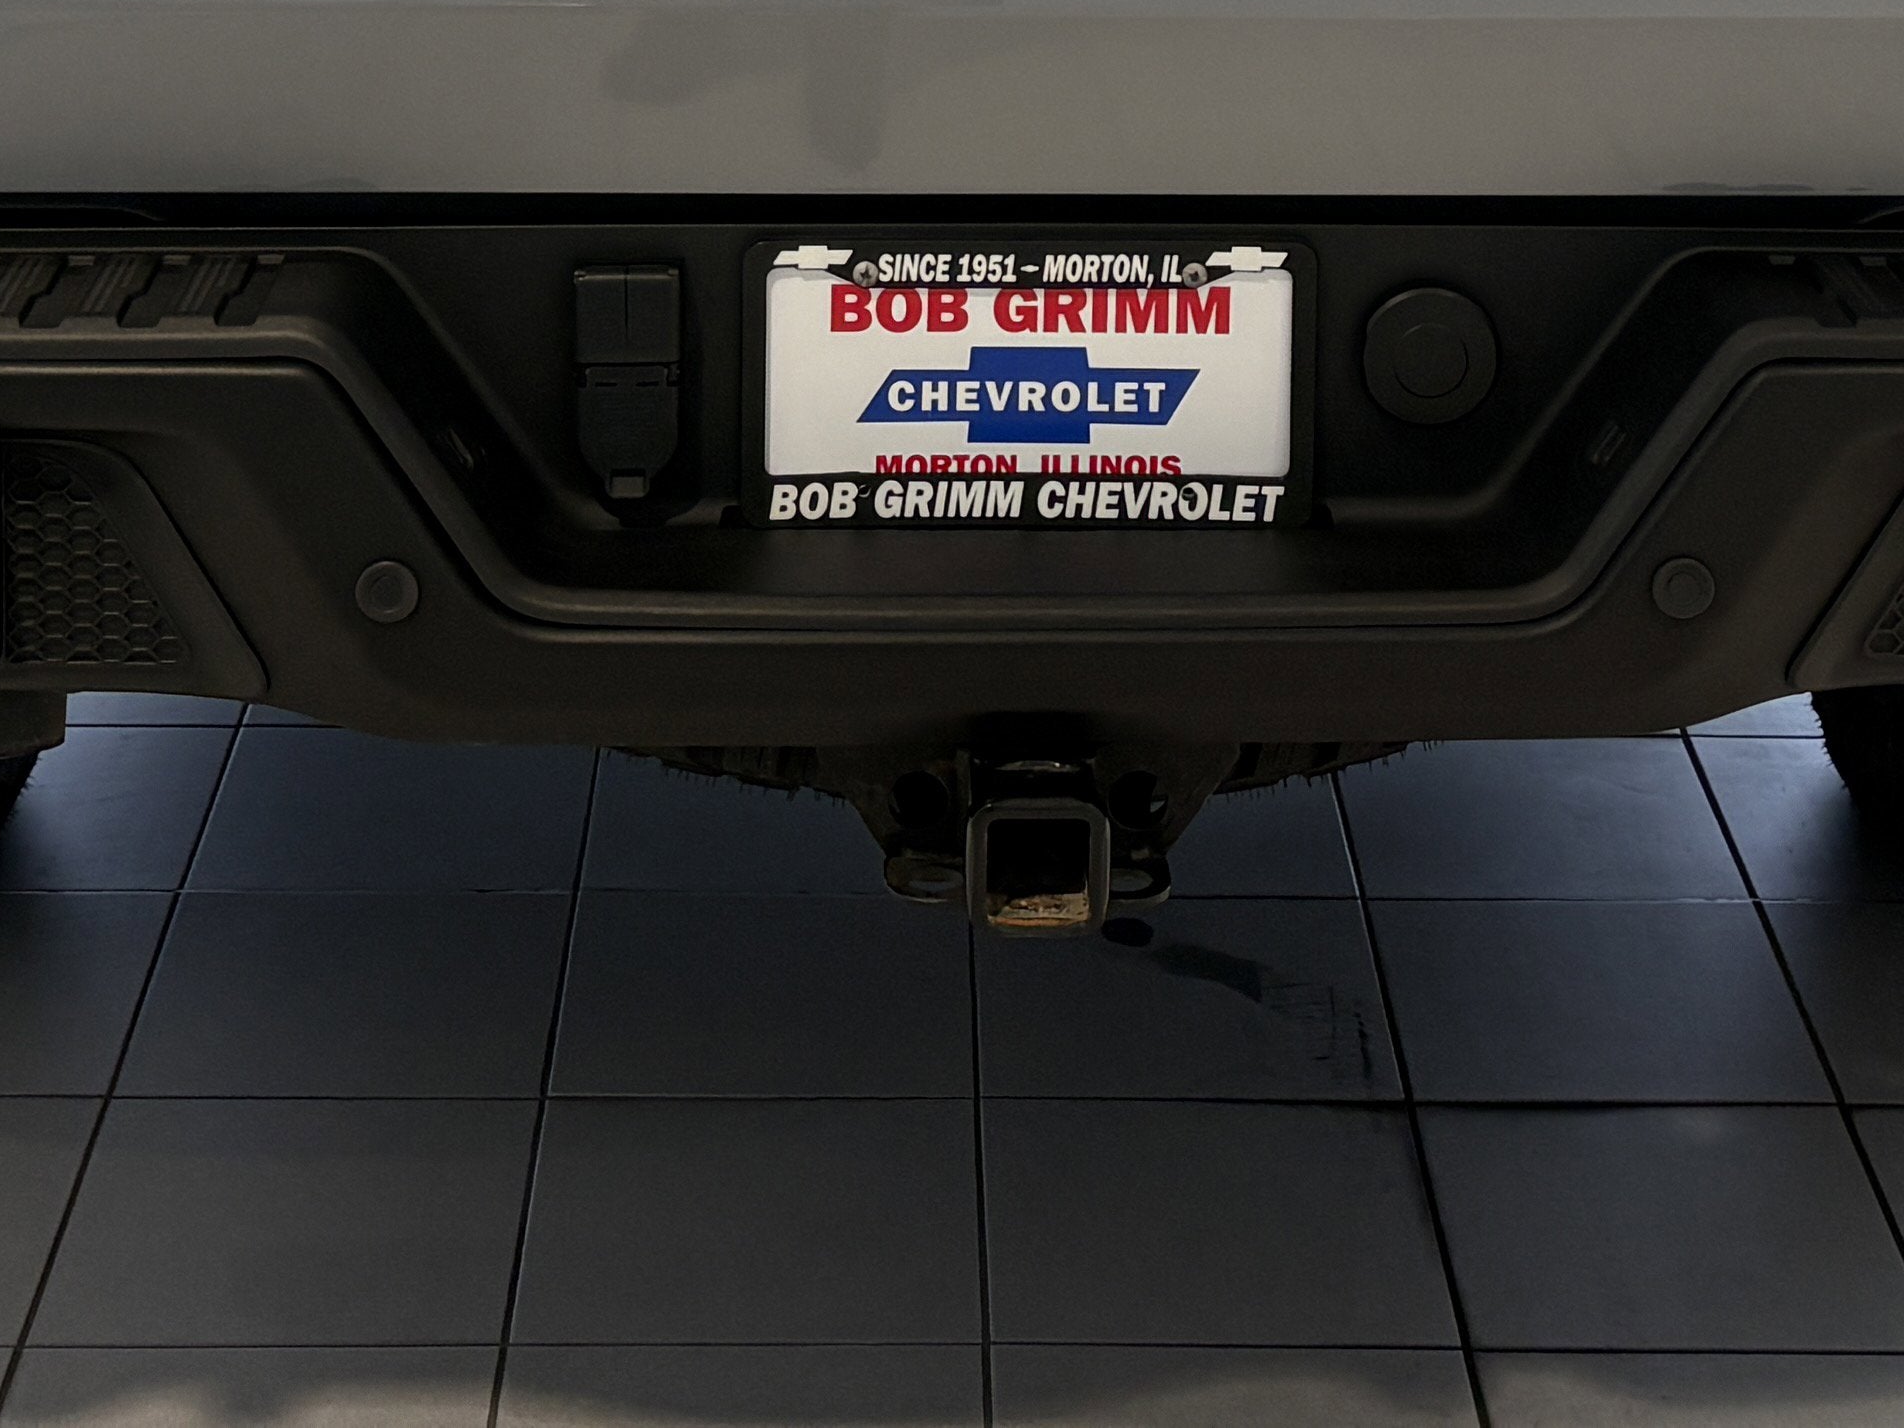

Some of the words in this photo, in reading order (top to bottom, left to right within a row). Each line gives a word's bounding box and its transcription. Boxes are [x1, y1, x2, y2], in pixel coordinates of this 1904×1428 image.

[878, 253, 951, 283] SINCE
[956, 253, 1017, 283] 1951
[1043, 254, 1154, 289] MORTON,
[1161, 254, 1182, 283] IL
[830, 284, 969, 332] BOB
[993, 287, 1231, 334] GRIMM
[887, 380, 1167, 413] CHEVROLET
[875, 455, 1017, 476] MORTON
[769, 482, 859, 520] BOB
[874, 479, 1024, 518] GRIMM
[1037, 480, 1285, 522] CHEVROLET
